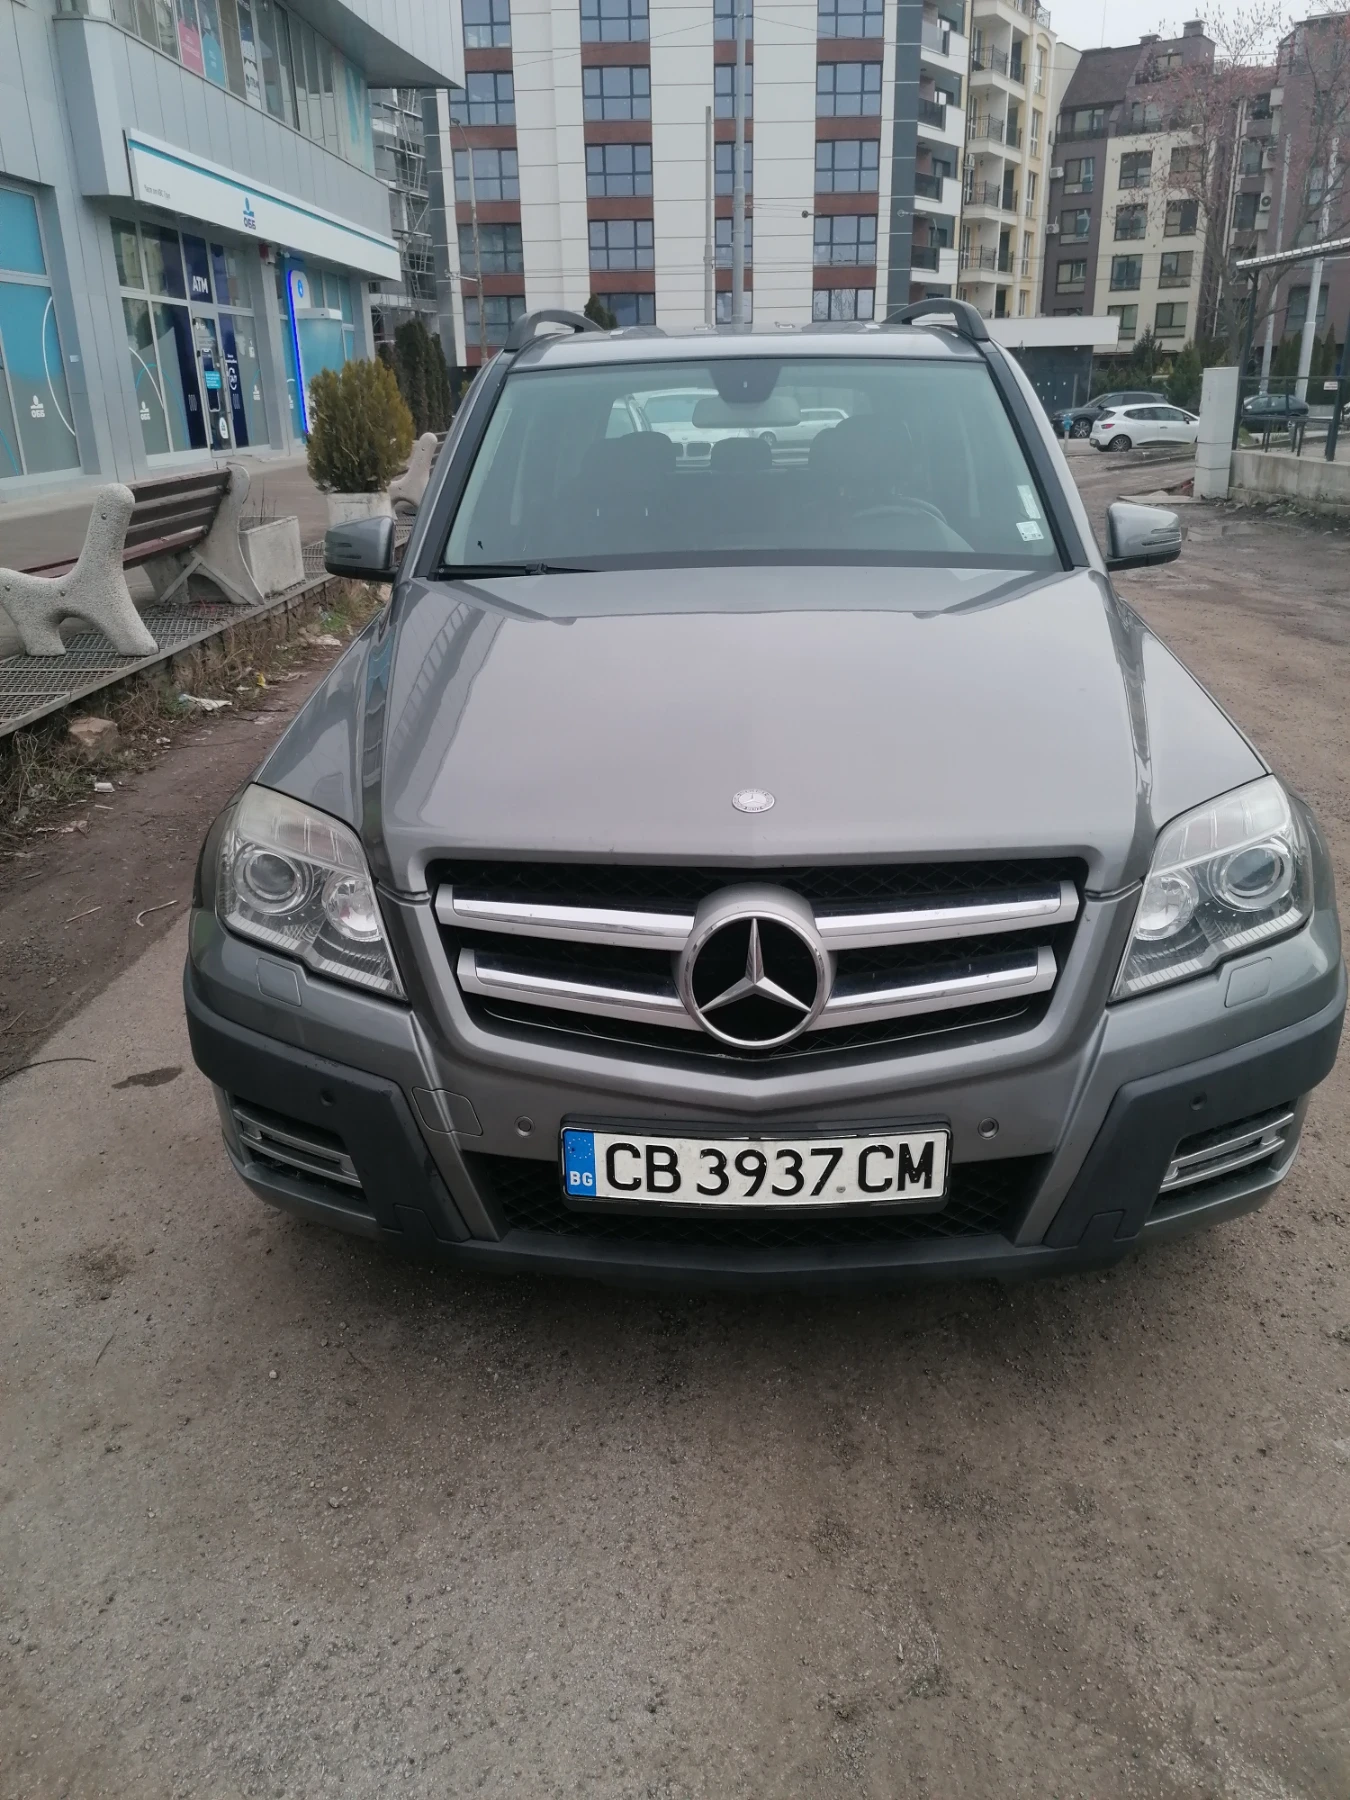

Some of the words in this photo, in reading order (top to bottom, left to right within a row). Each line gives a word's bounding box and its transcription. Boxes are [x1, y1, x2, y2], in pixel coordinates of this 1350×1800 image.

[192, 275, 209, 294] ATM
[569, 1170, 593, 1187] BG
[605, 1142, 682, 1193] CB
[696, 1147, 843, 1197] 3937
[857, 1141, 934, 1193] CM
